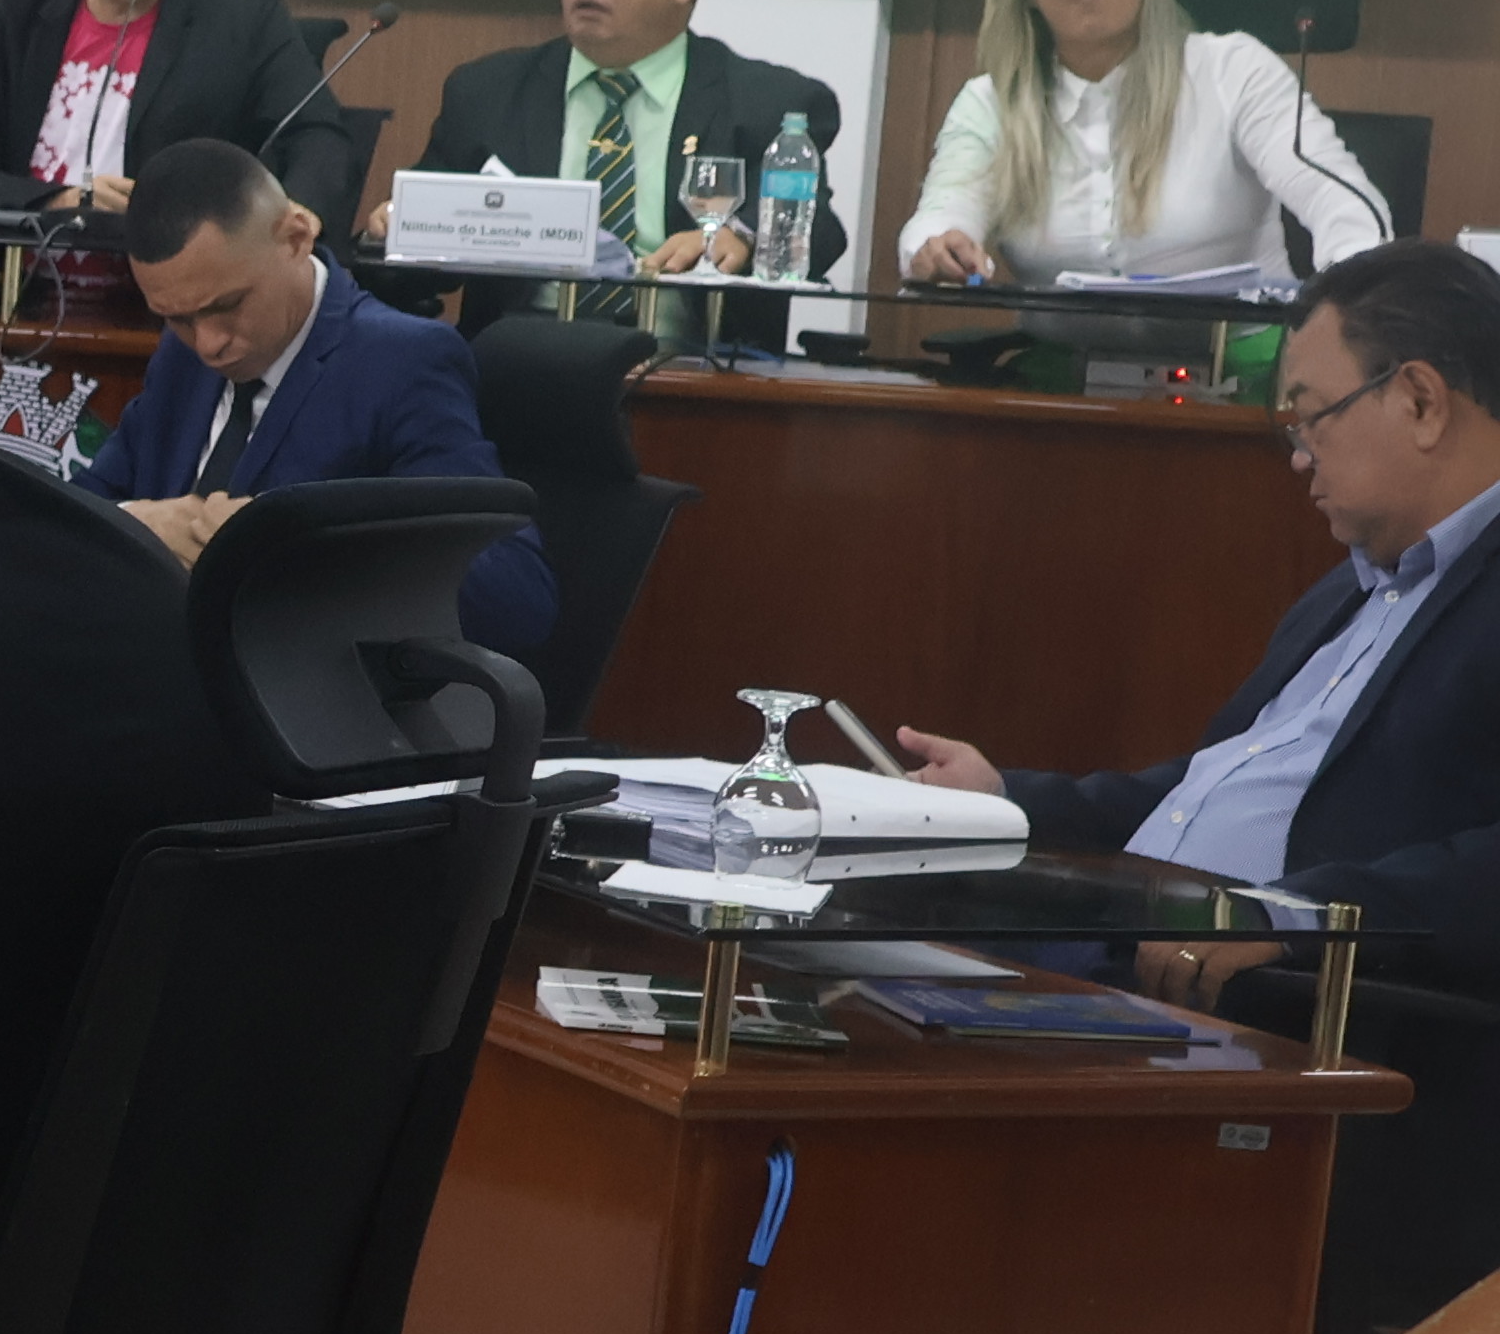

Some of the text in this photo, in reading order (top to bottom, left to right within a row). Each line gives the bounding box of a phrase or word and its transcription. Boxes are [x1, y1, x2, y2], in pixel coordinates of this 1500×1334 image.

[401, 220, 584, 244] Niltinho do Lanche (MDB)
